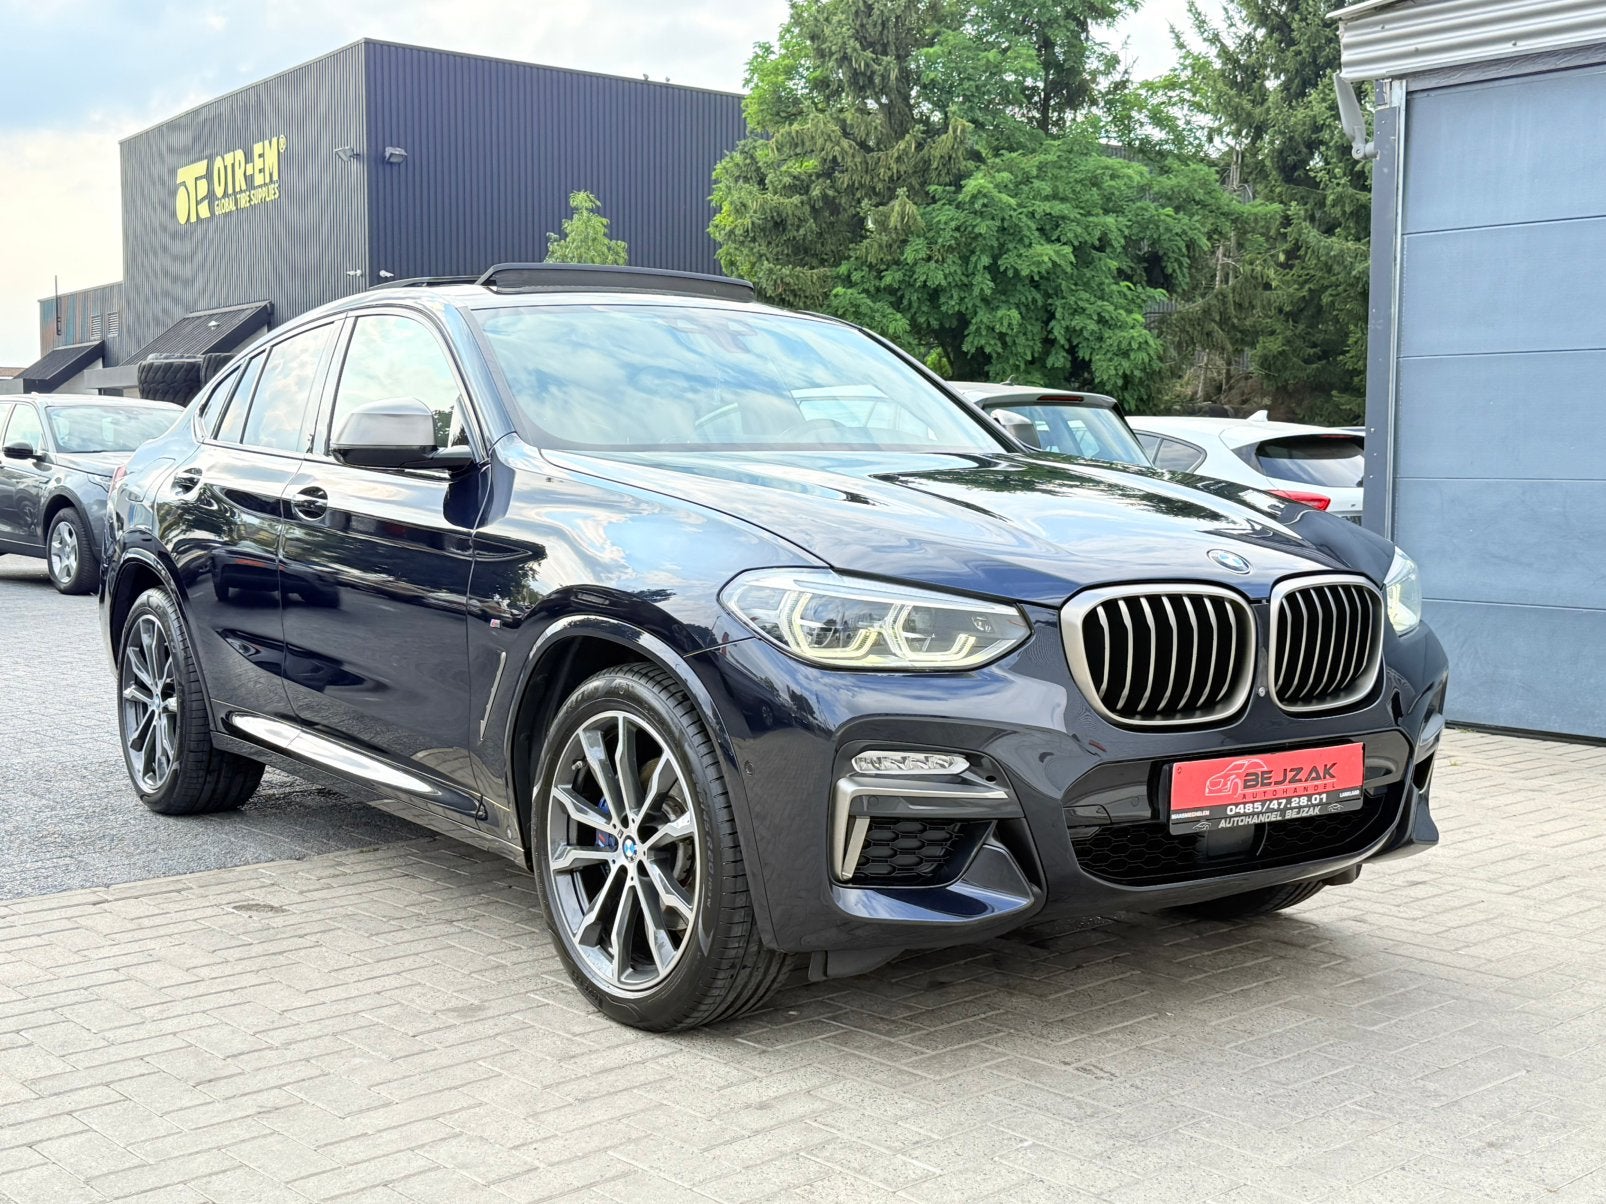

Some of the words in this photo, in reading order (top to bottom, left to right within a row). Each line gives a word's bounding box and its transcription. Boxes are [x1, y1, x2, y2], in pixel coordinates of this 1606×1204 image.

[1243, 762, 1338, 790] BEJZAK
[1241, 782, 1337, 800] AUTOHANDEL
[1226, 793, 1327, 816] 0485/47.28.01
[1218, 811, 1283, 829] AUTOHANDEL
[1285, 805, 1321, 819] BEJZAK
